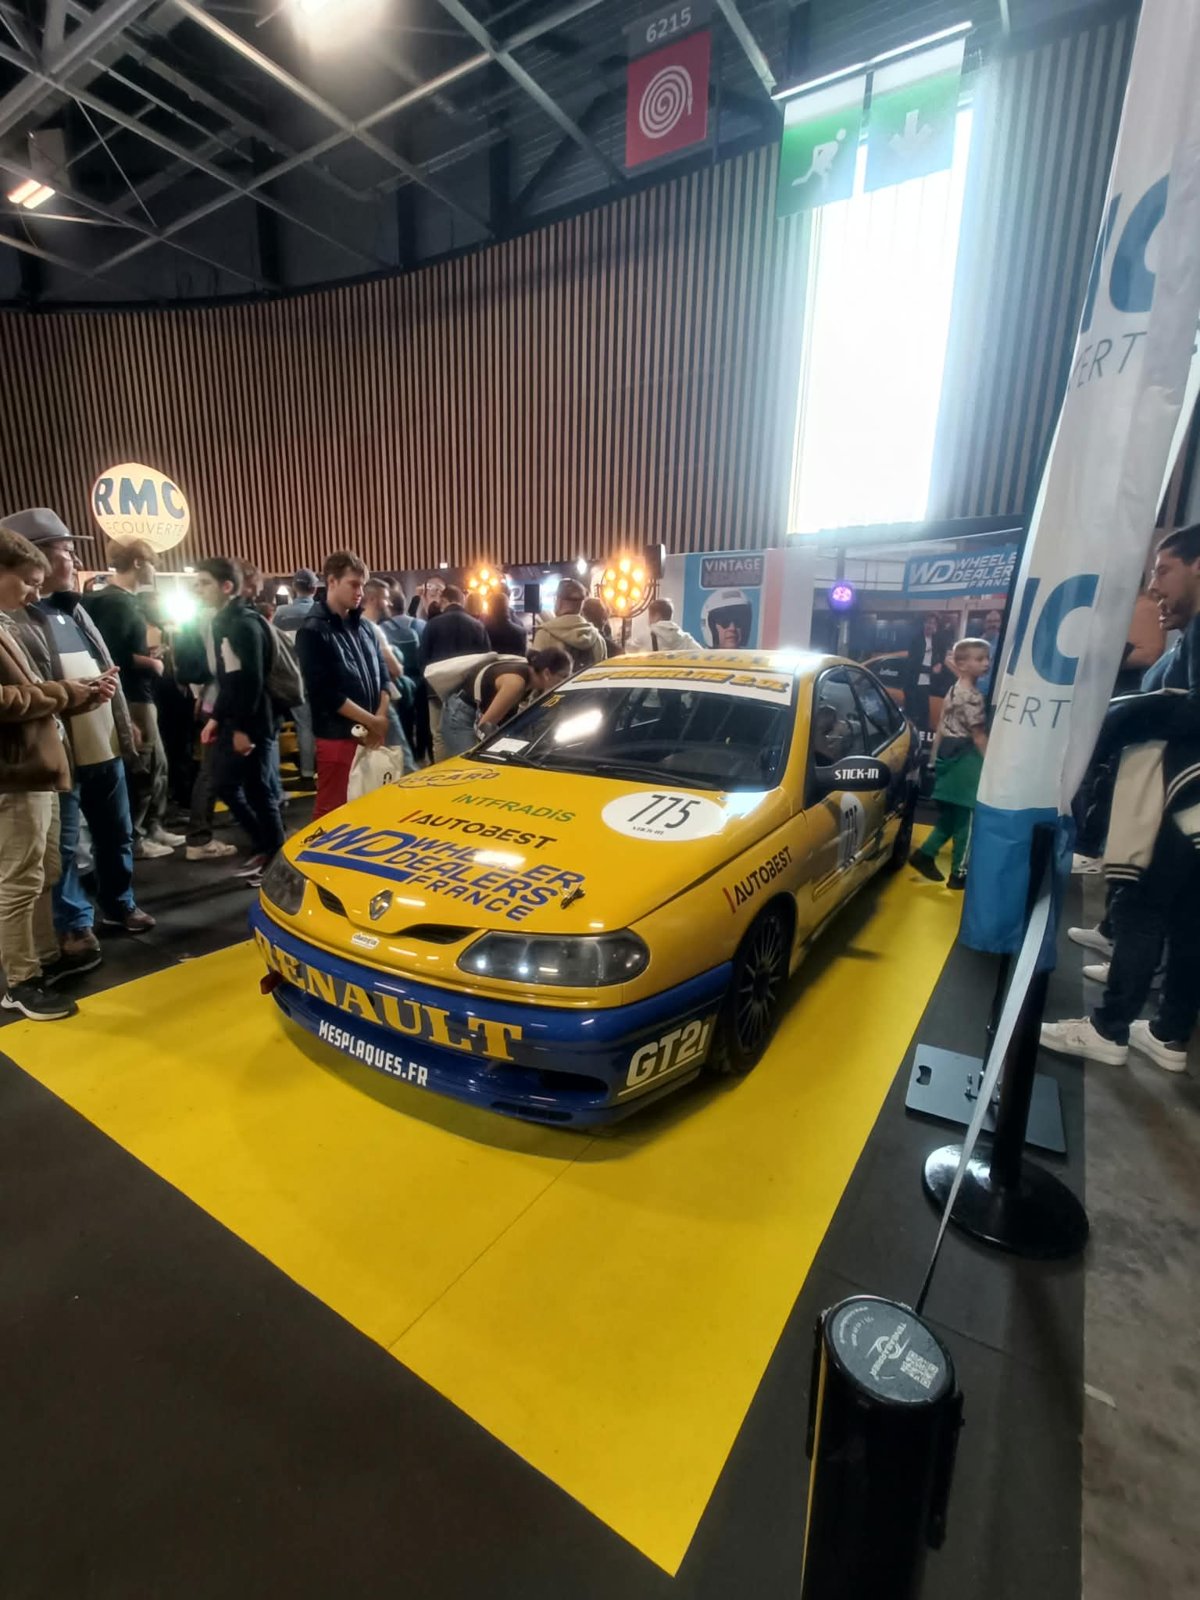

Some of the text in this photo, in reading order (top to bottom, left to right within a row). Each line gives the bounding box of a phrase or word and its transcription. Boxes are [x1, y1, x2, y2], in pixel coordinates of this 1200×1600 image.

[646, 6, 691, 42] 6215
[94, 477, 185, 520] RMC
[704, 558, 761, 572] VINTAGE
[909, 551, 1017, 584] WD WHEELE
[952, 565, 1014, 582] DEALER
[968, 578, 1010, 588] FRANC
[627, 794, 701, 828] 775
[410, 813, 557, 849] AUTOBEST
[308, 824, 585, 889] WD WHEER
[734, 846, 793, 906] AUTOBEST
[384, 851, 558, 906] DEALERS
[407, 876, 535, 921] FRANCE
[254, 926, 522, 1061] RENAULT
[319, 1020, 428, 1087] MESPLAQUES.FR
